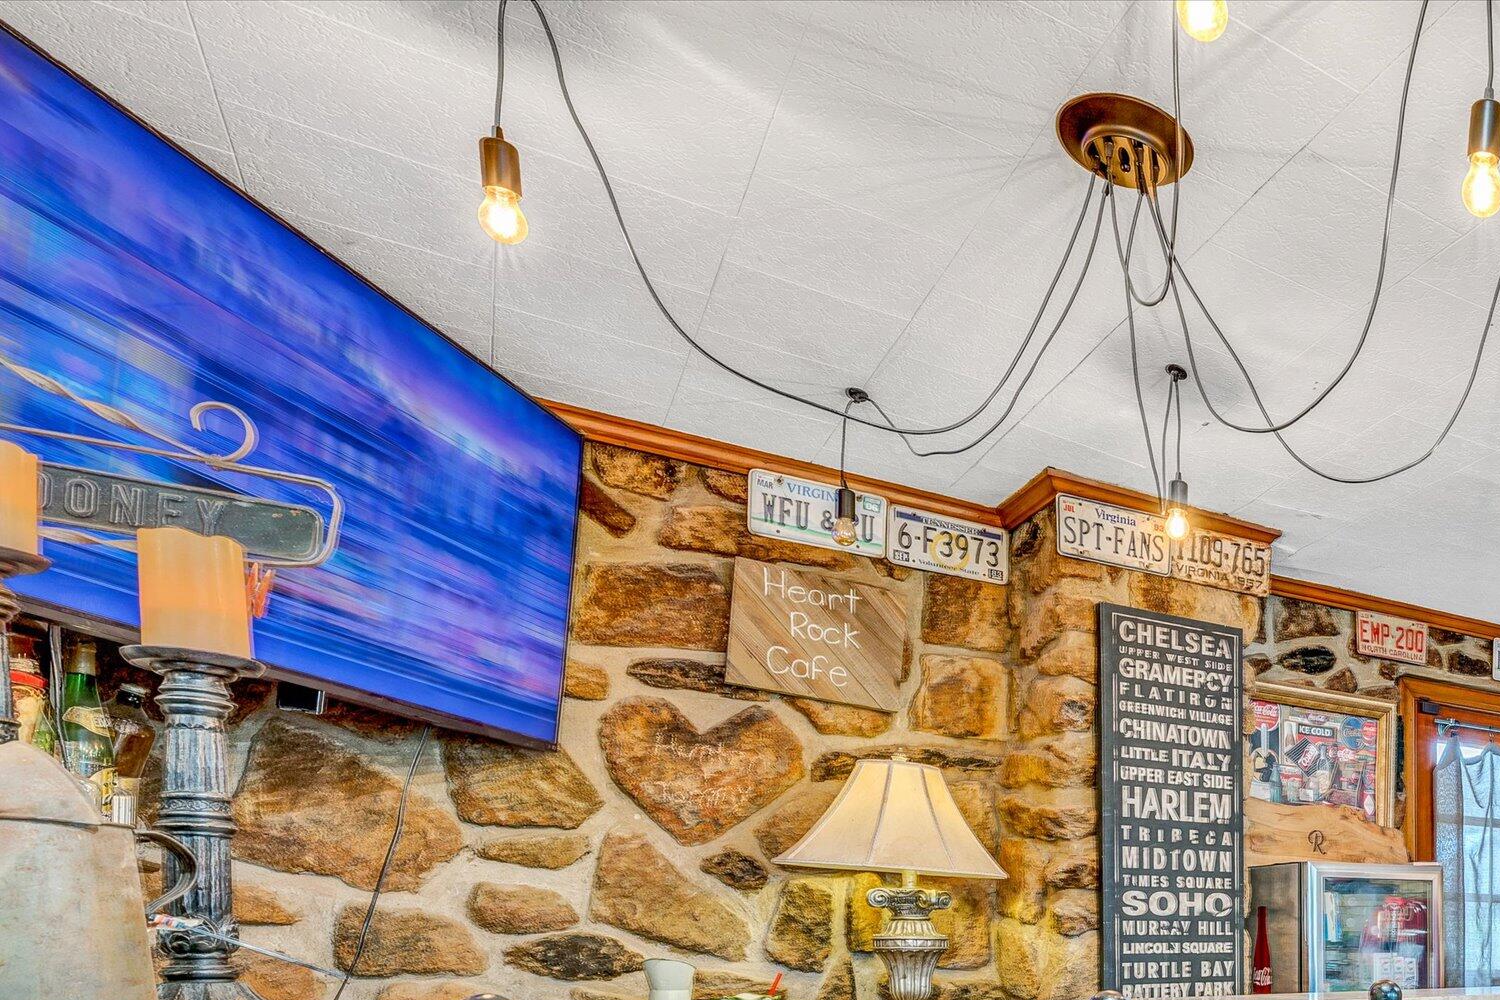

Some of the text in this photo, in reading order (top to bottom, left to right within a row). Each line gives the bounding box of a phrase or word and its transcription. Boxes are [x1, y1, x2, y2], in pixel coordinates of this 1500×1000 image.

[757, 478, 773, 490] MAR
[762, 493, 810, 530] WFU
[821, 510, 834, 532] &
[1063, 503, 1075, 513] JUL
[1095, 507, 1137, 527] Virginia
[921, 517, 984, 536] TENNESSEE
[1063, 516, 1165, 562] SPT-FANS
[898, 522, 999, 568] 6-F3973
[919, 559, 957, 571] Volunteer
[1176, 562, 1264, 589] VIRGINIA 1957
[763, 567, 862, 614] Heart
[790, 611, 861, 649] Rock
[1119, 621, 1233, 659] CHELSEA
[767, 645, 848, 687] Cafe
[1118, 645, 1233, 672] UPPER WEST SIDE
[1361, 645, 1423, 660] NORTH CAROLINA
[1119, 657, 1233, 692] GRAMERCY
[1119, 681, 1233, 711] FLATIRON
[1119, 700, 1233, 726] GREENWICH VILLAGE
[1119, 718, 1232, 750] CHINATOWN
[1299, 723, 1310, 735] ICE
[1310, 727, 1333, 737] COLD
[1121, 745, 1232, 772] LITTLE ITALY
[1120, 765, 1233, 790] UPPER EAST SIDE
[1121, 785, 1233, 825] HARLEM
[1121, 824, 1233, 846] TRIBECA
[1121, 845, 1233, 873] MIDTOWN
[1122, 873, 1232, 890] TIMES SQUARE
[1121, 890, 1233, 918] SOHO
[1121, 920, 1234, 936] MURRAY HILL
[1122, 941, 1233, 955] LINCOLN SQUARE
[1121, 960, 1235, 979] TURTLE BAY
[1121, 981, 1235, 998] BATTERY PARK
